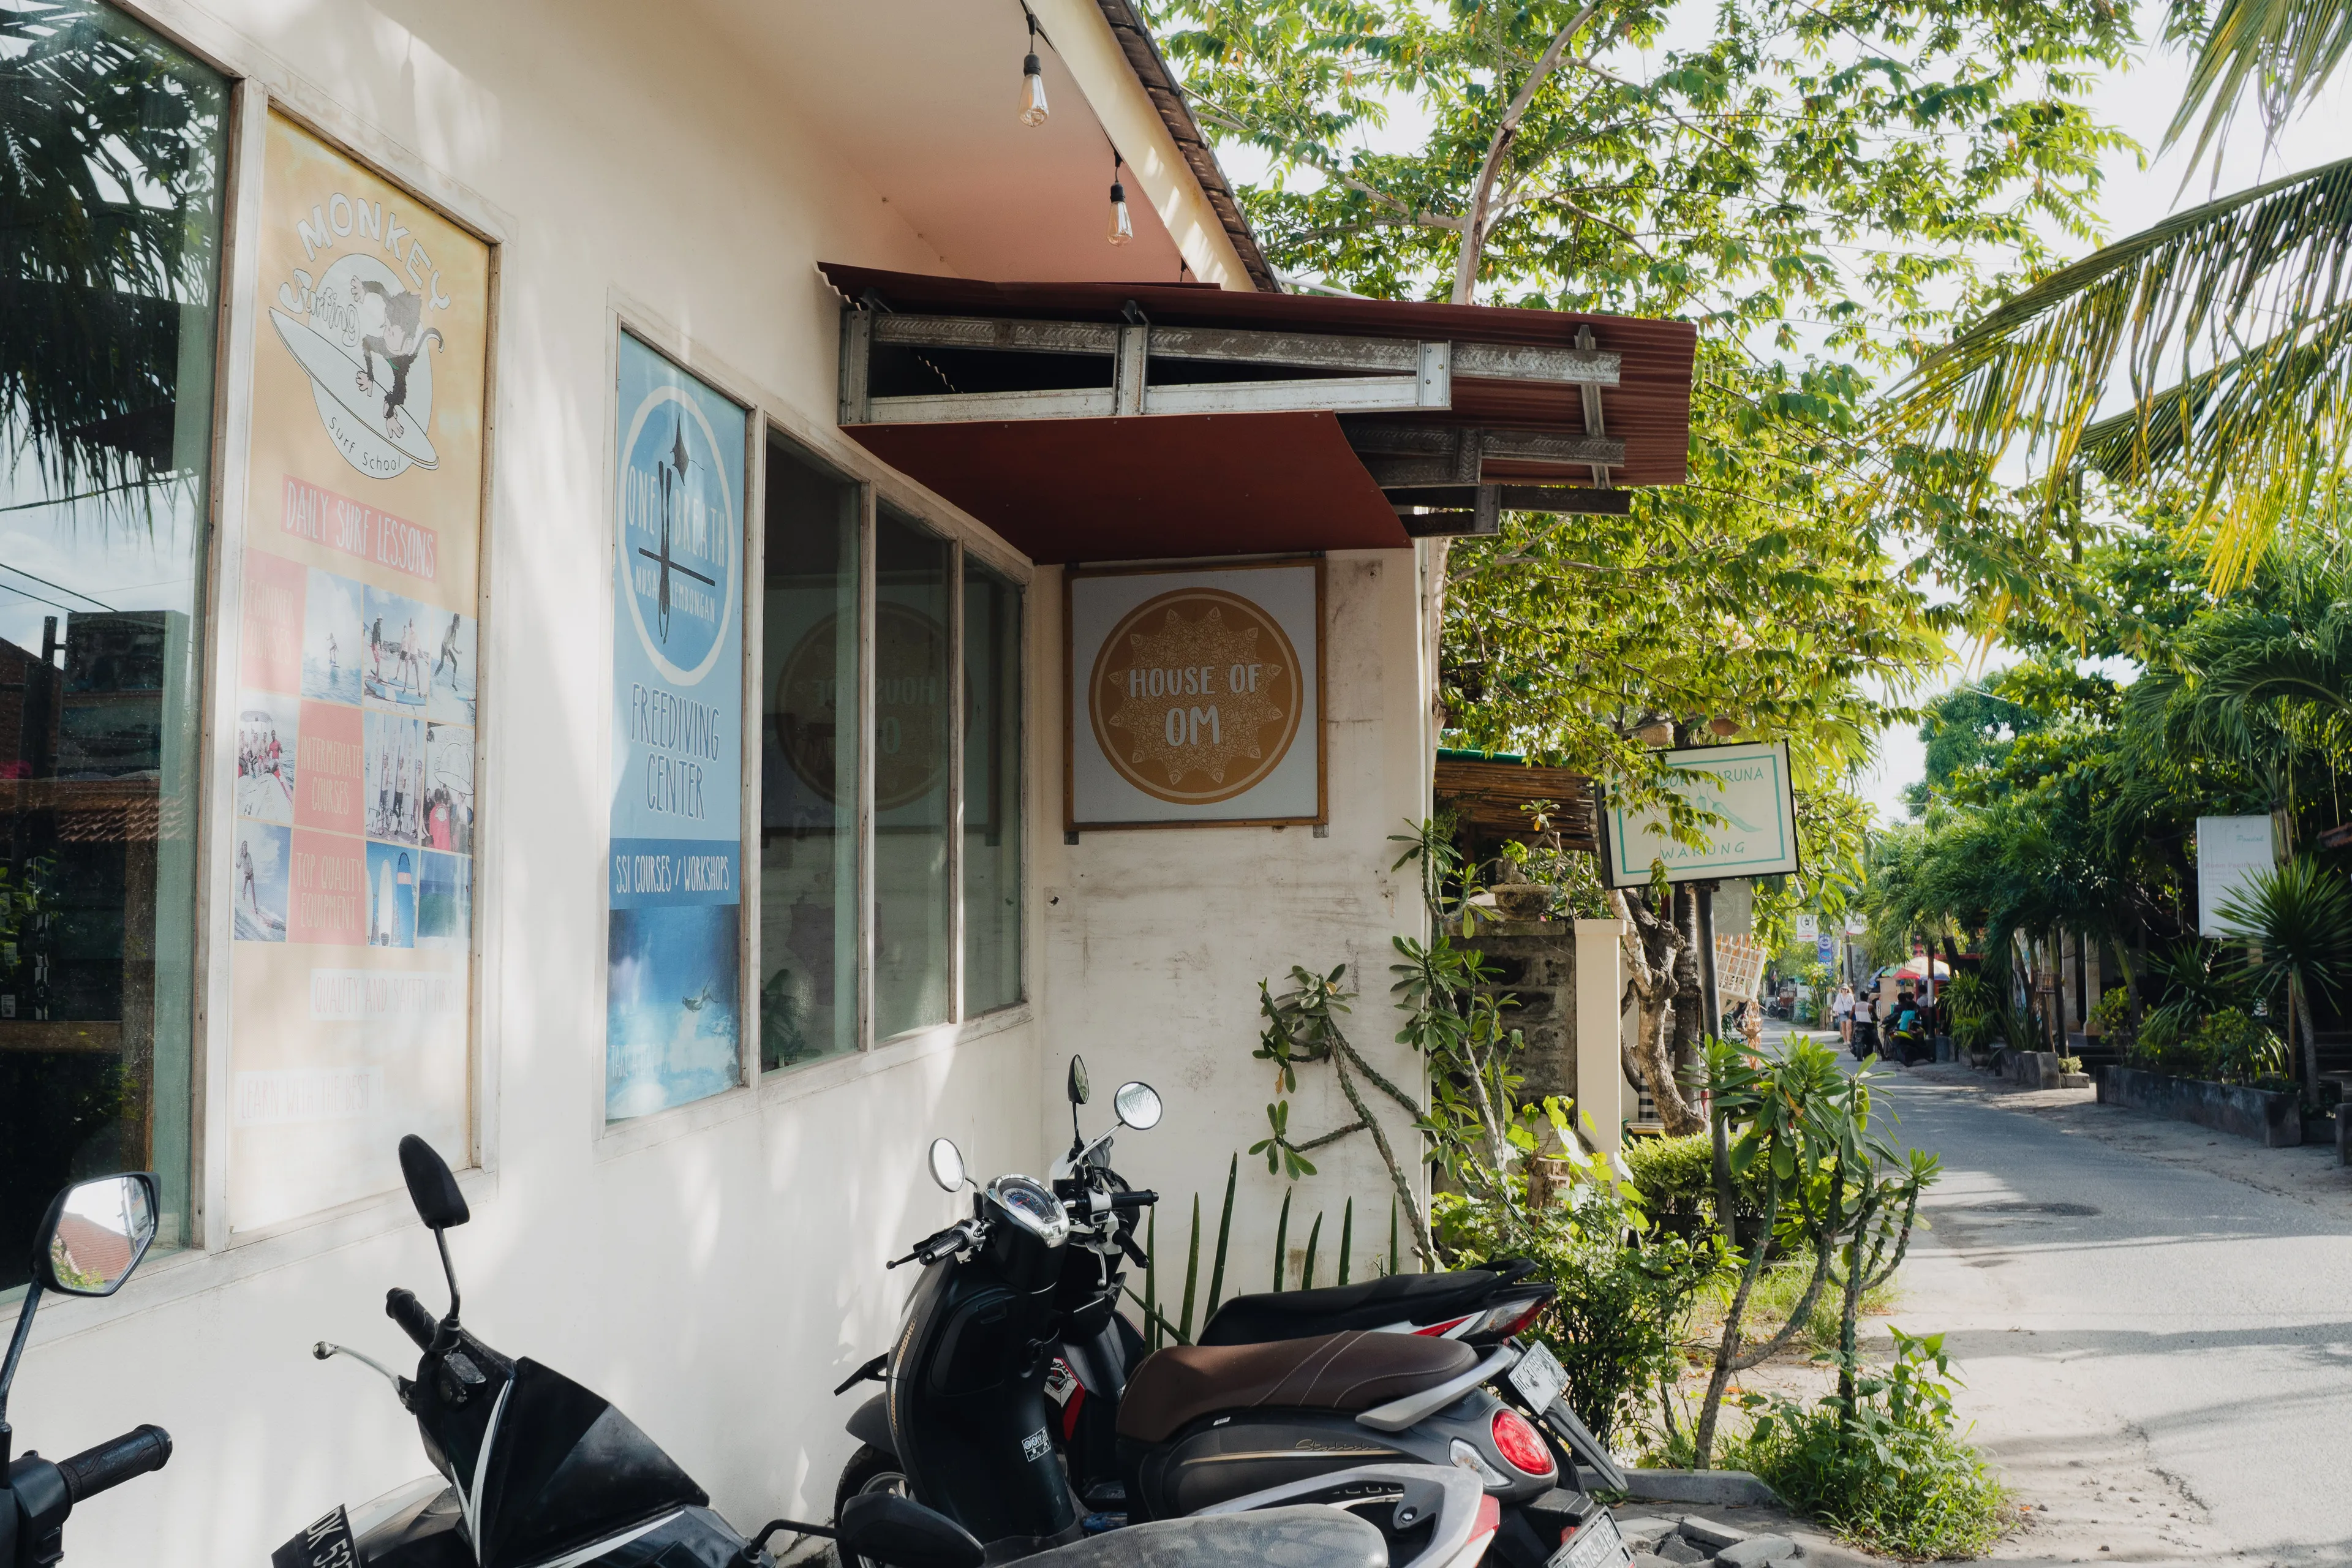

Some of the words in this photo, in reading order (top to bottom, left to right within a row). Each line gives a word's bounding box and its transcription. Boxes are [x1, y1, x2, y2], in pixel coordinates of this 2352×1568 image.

[296, 192, 451, 311] MONKEY
[278, 268, 361, 347] Surfing
[329, 417, 355, 453] Surf
[362, 452, 401, 471] School
[286, 481, 329, 542] DAILY
[336, 500, 371, 556] SURF
[377, 514, 434, 578] LESSONS
[628, 465, 657, 536] ONE
[674, 489, 725, 568] BREATH
[636, 565, 658, 600] NUSA
[669, 579, 715, 623] LEMBONGAN
[1129, 666, 1216, 698] HOUSE
[1229, 663, 1262, 693] OF
[631, 682, 720, 761] FREEDIVING
[1165, 704, 1220, 747] OM
[300, 735, 362, 778] INTERMEDIATE
[311, 777, 350, 815] COURSES
[646, 752, 705, 821] CENTER
[296, 853, 315, 888] TOP
[321, 854, 363, 892] QUALITY
[1661, 842, 1744, 860] WARUNG
[616, 855, 630, 894] SSI
[635, 855, 671, 893] COURSES
[684, 855, 729, 892] WORKSHOPS
[300, 892, 357, 930] EQUIPMENT
[315, 977, 359, 1013] QUALITY
[365, 979, 387, 1013] AND
[393, 979, 429, 1013] SAFETY
[610, 1044, 628, 1077] TAKE
[241, 1079, 279, 1120] LEARN
[287, 1078, 314, 1116] WITH
[321, 1076, 339, 1114] THE
[345, 1074, 371, 1112] BEST
[1513, 1373, 1530, 1395] DK
[306, 1507, 344, 1551] DK
